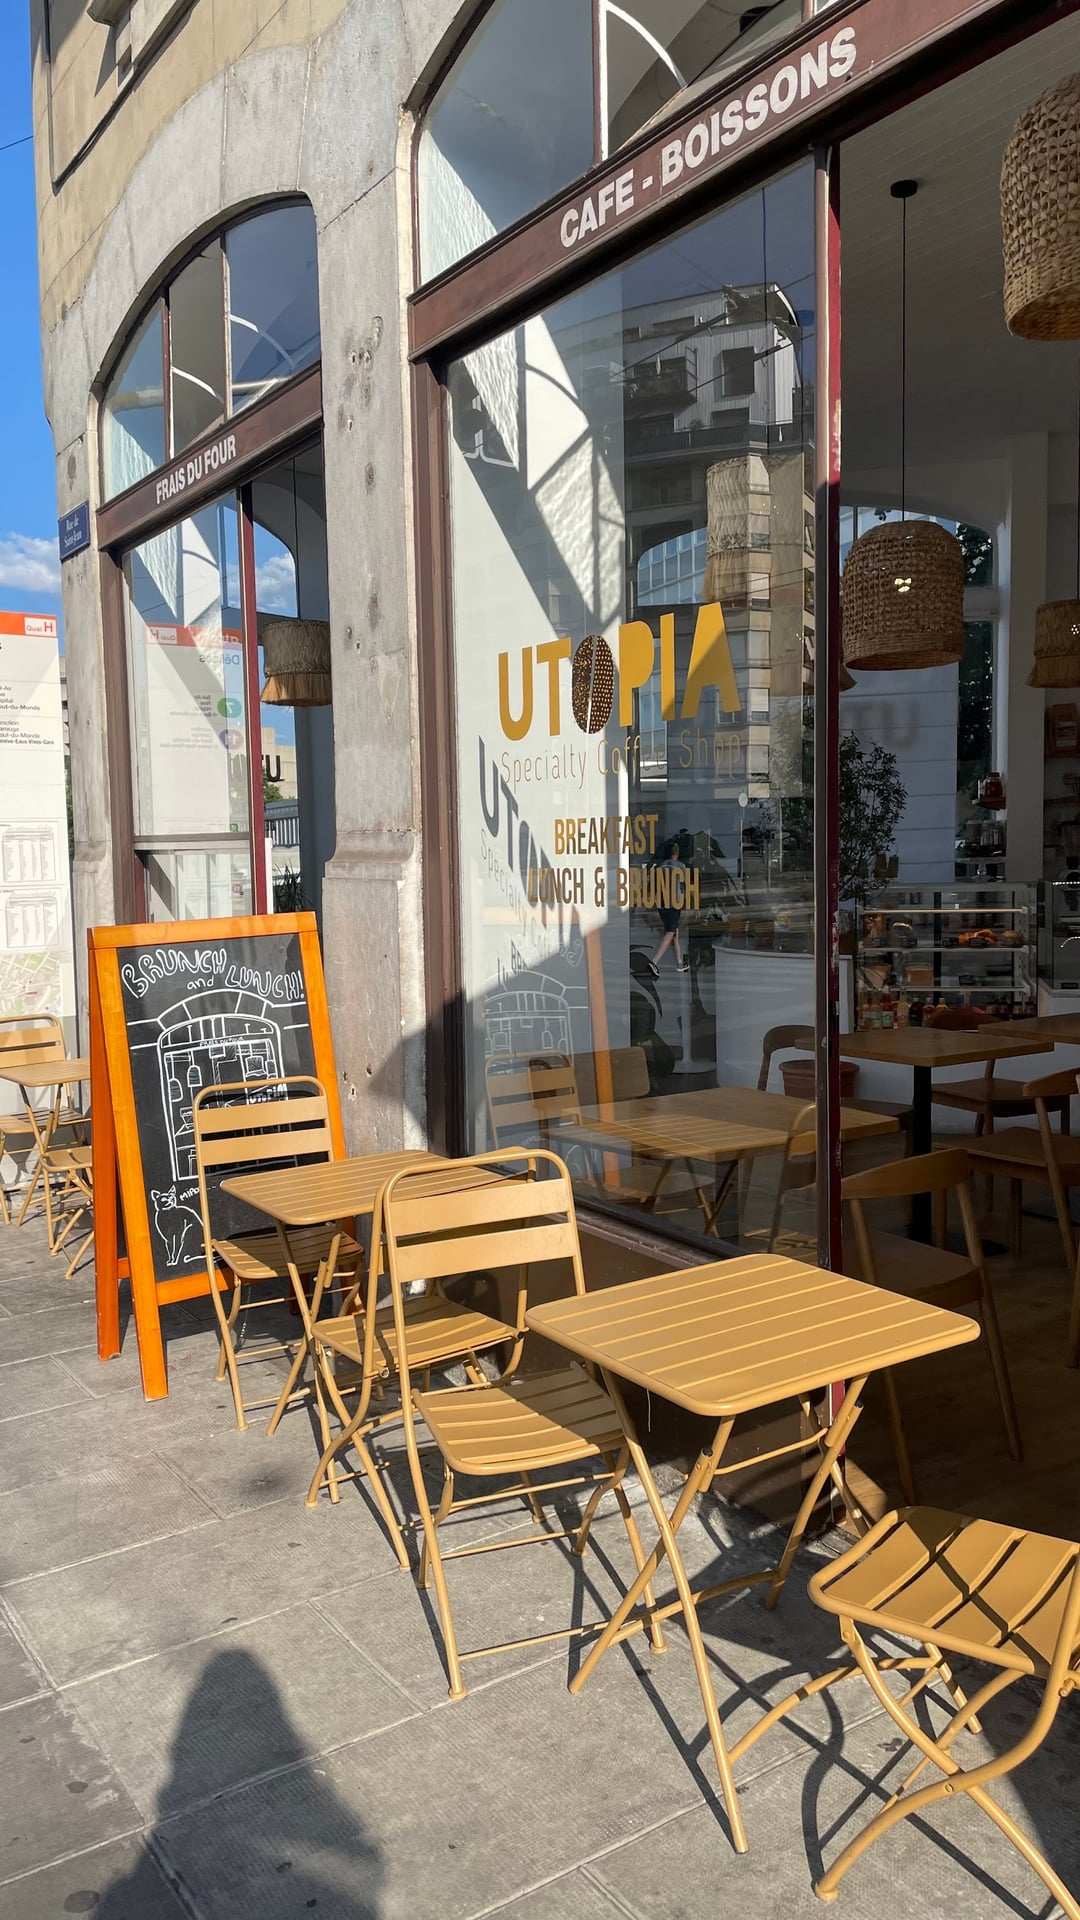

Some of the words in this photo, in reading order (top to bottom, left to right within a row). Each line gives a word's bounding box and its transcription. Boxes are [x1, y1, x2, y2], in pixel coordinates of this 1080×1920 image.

[560, 168, 635, 248] CAFE
[643, 176, 653, 190] -
[662, 27, 857, 187] BOISSONS
[156, 467, 186, 504] FRAIS
[187, 456, 203, 483] DU
[204, 434, 237, 475] FOUR
[66, 519, 74, 531] Rue
[74, 514, 79, 527] de
[44, 621, 54, 633] H
[498, 602, 742, 741] UTOPIA
[501, 744, 587, 794] Specialty
[597, 735, 666, 776] Coffee
[679, 728, 742, 780] Shop
[555, 814, 659, 856] BREAKFAST
[529, 867, 585, 905] LUNCH
[594, 866, 605, 908] &
[616, 867, 700, 910] BRUNCH
[121, 948, 227, 999] BRUNCH
[187, 975, 214, 990] and
[225, 965, 304, 1000] LUNCH!
